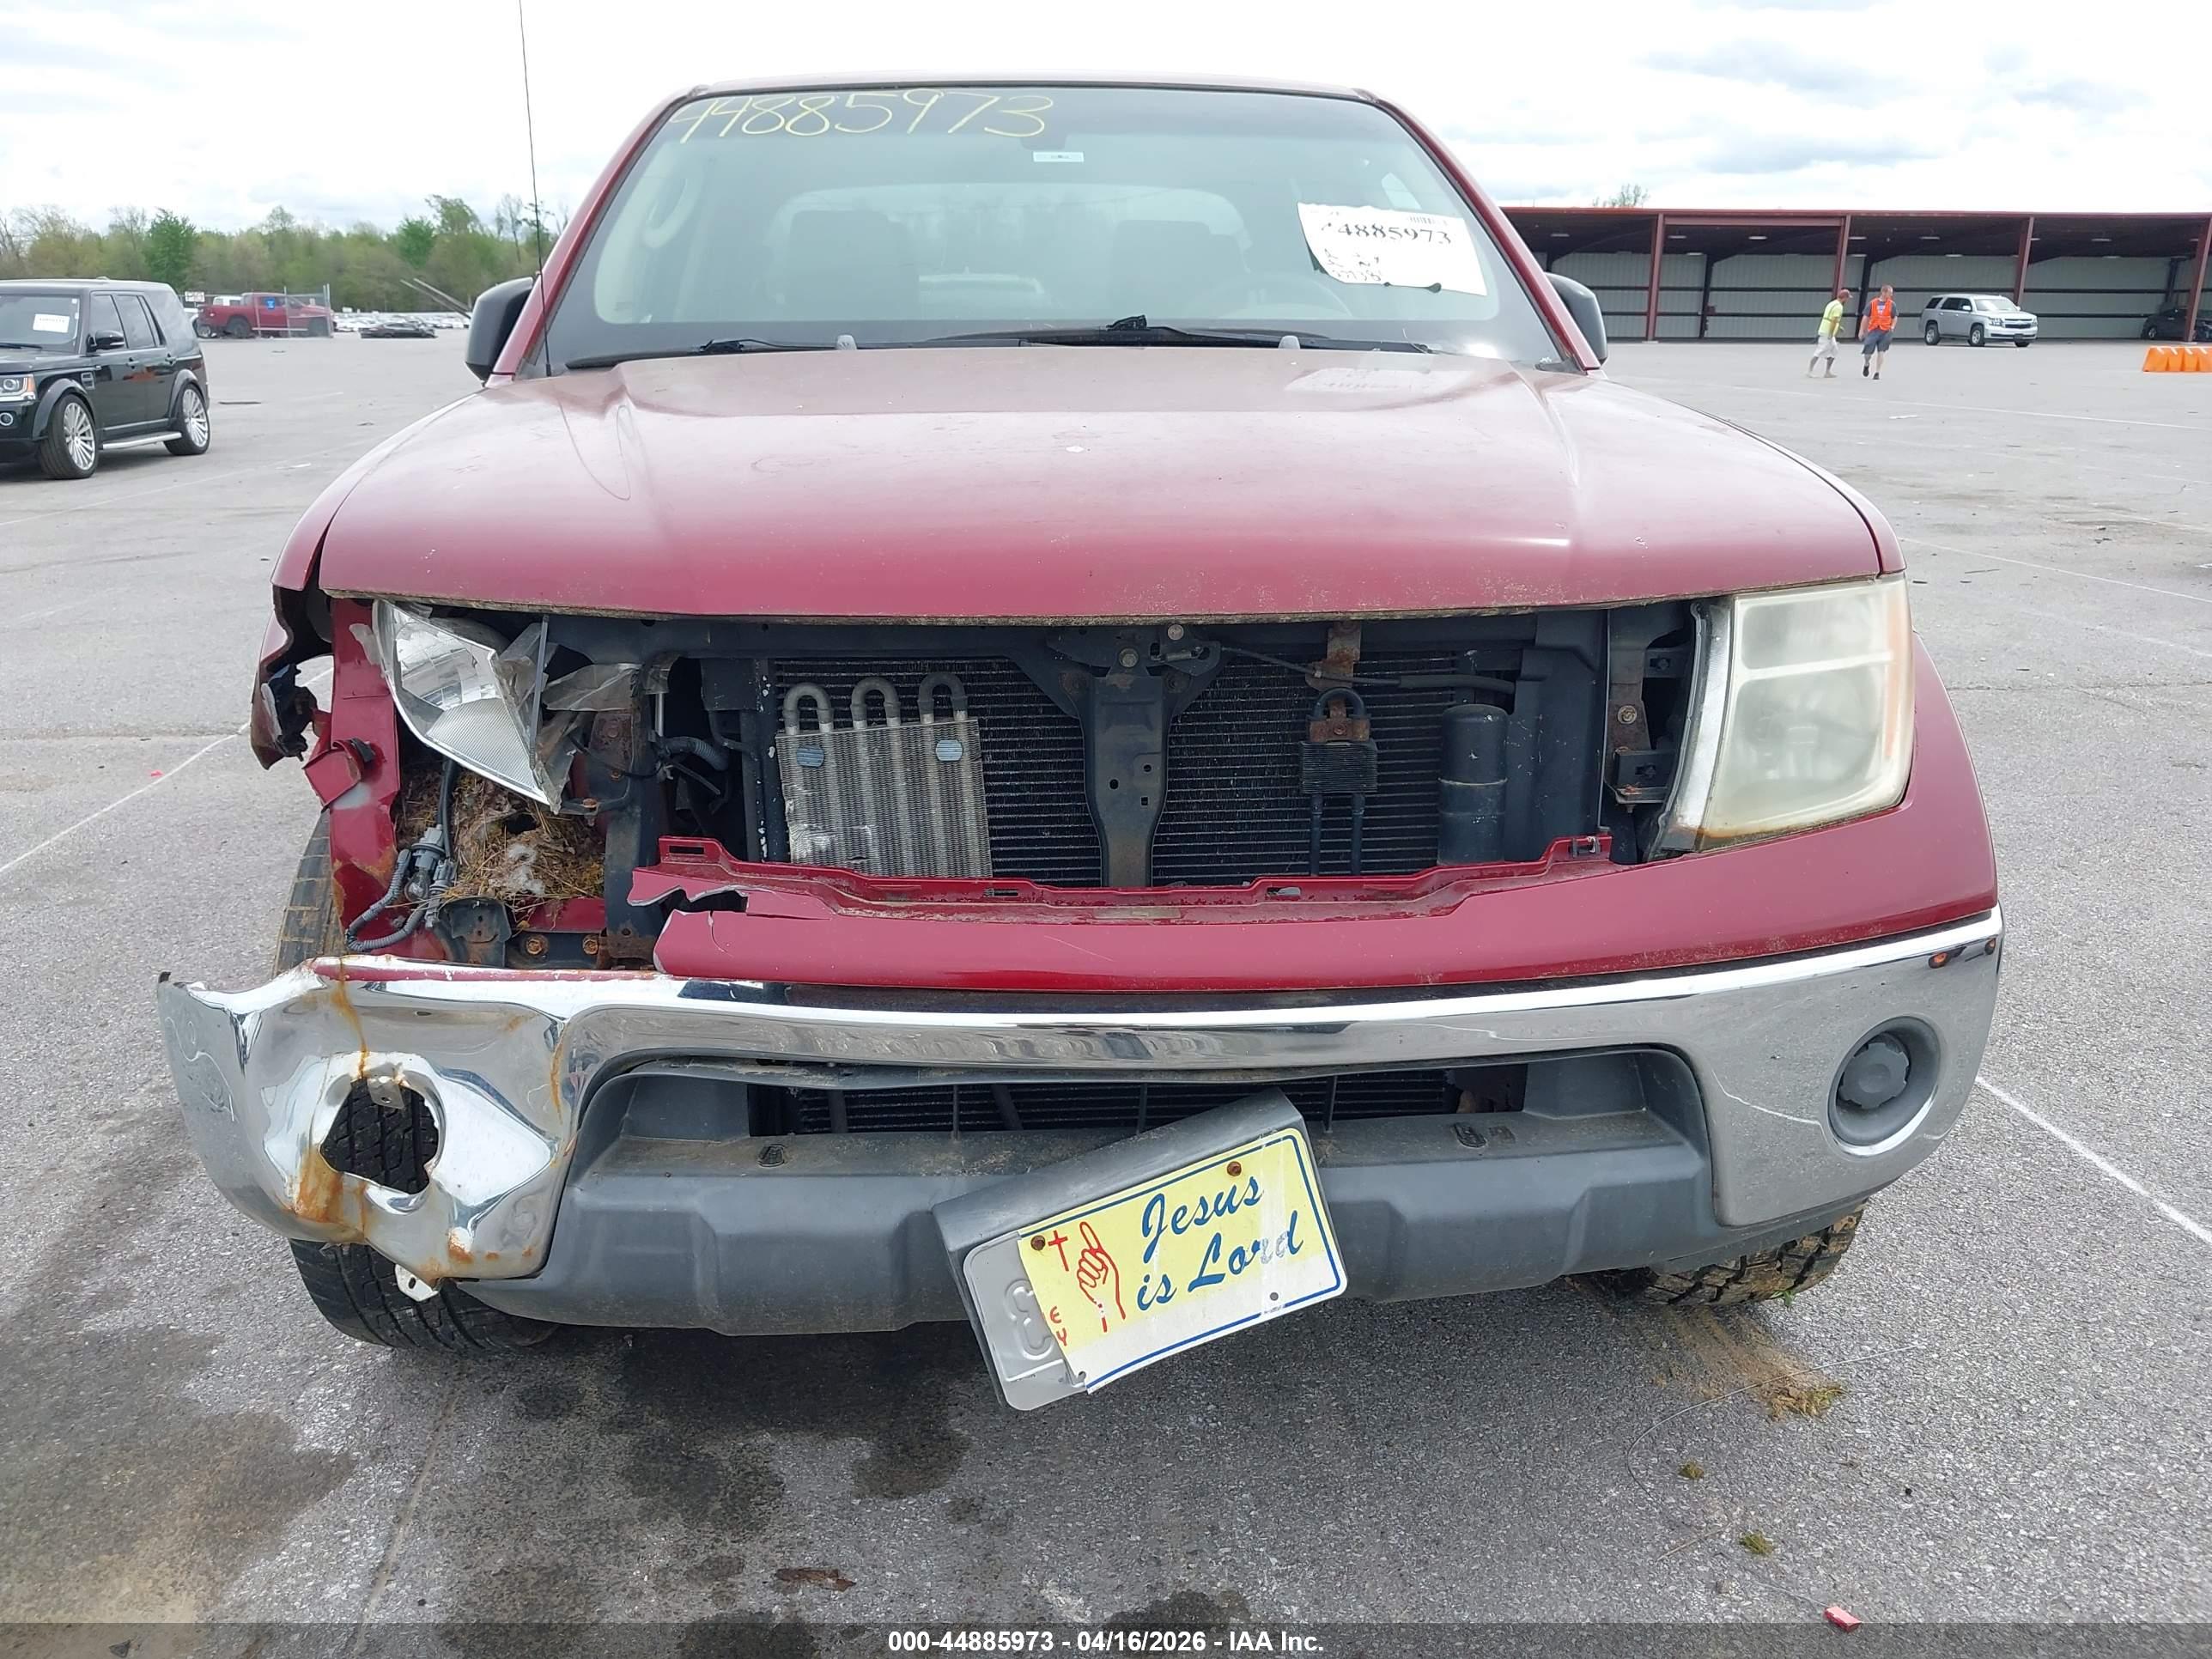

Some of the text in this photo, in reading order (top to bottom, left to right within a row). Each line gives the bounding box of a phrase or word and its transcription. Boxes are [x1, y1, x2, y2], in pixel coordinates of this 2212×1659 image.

[670, 89, 1054, 144] 44885973
[1321, 222, 1452, 245] 4885973
[1141, 1176, 1263, 1265] Jesus
[1137, 1210, 1304, 1312] is Lord
